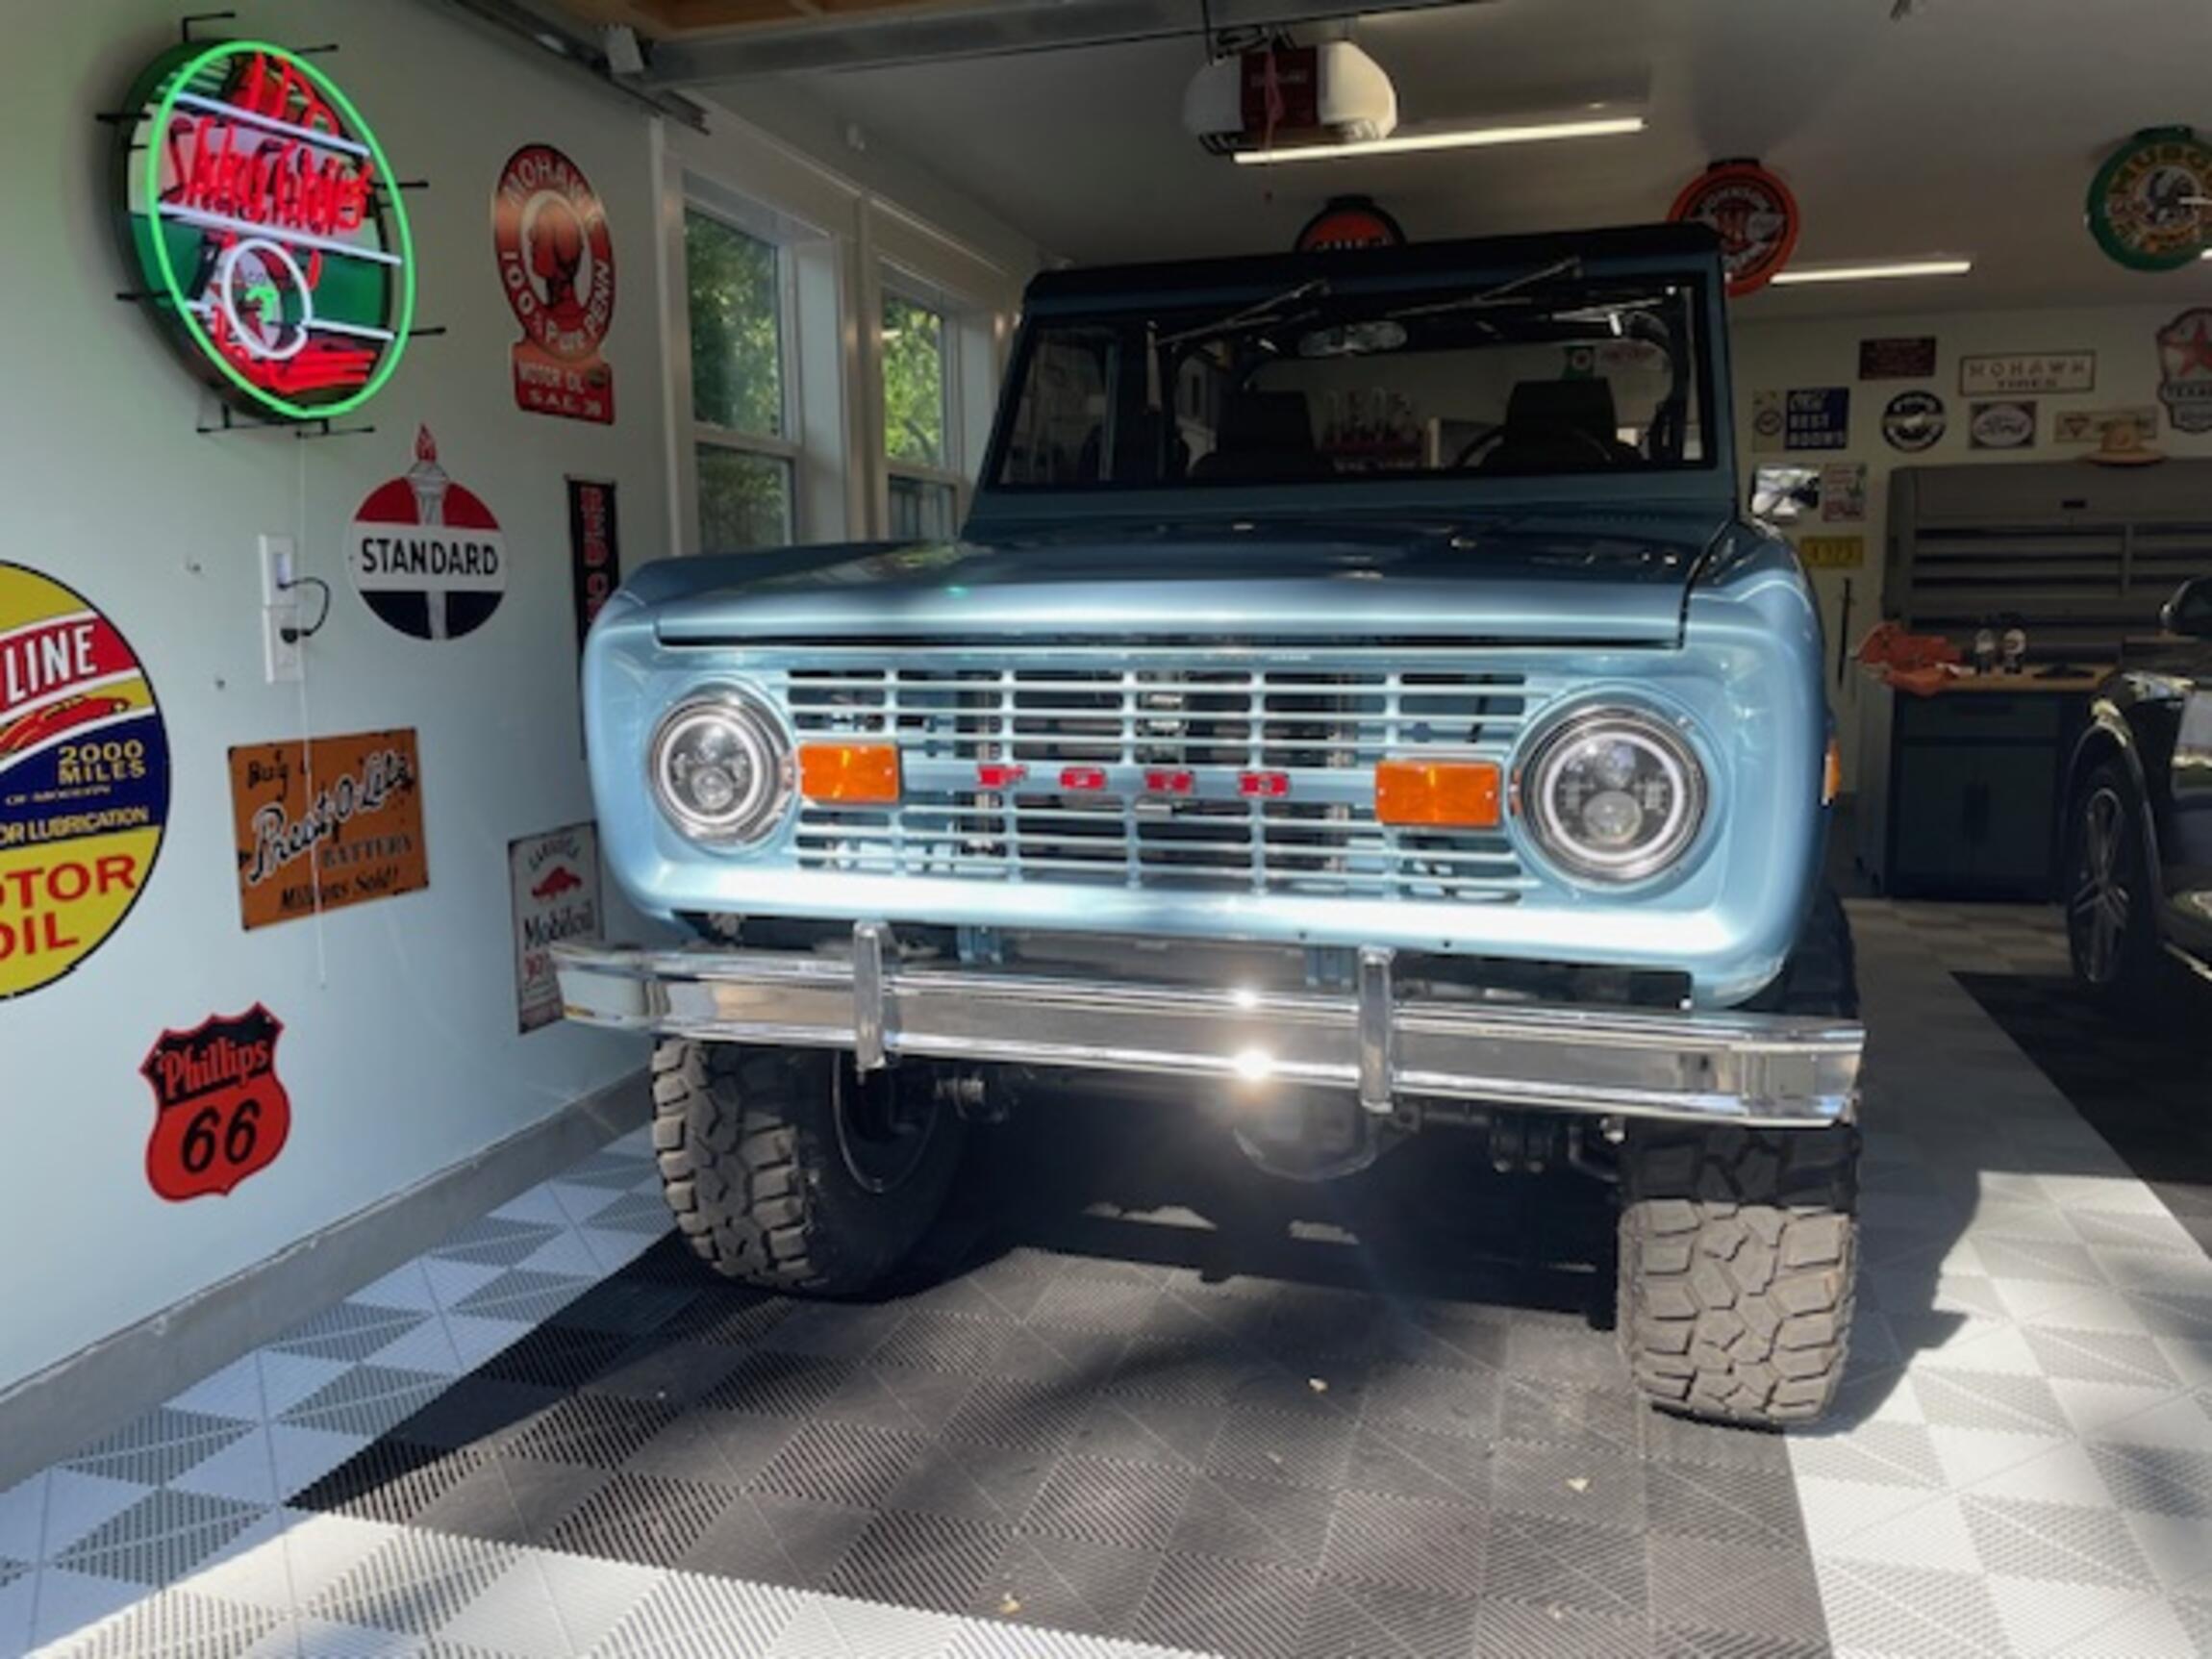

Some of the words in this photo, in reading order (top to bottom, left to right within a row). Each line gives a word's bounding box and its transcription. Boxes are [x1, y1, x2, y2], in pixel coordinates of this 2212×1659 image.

[1969, 359, 2086, 377] MOHAWK
[362, 538, 499, 577] STANDARD
[4, 624, 97, 705] LINE
[58, 739, 145, 766] 2000
[58, 758, 146, 786] MILES
[976, 764, 1289, 797] FORD
[27, 806, 149, 842] LUBRICATION
[0, 854, 137, 910] TOR
[158, 1036, 269, 1101] Phillips
[181, 1098, 262, 1173] 66
